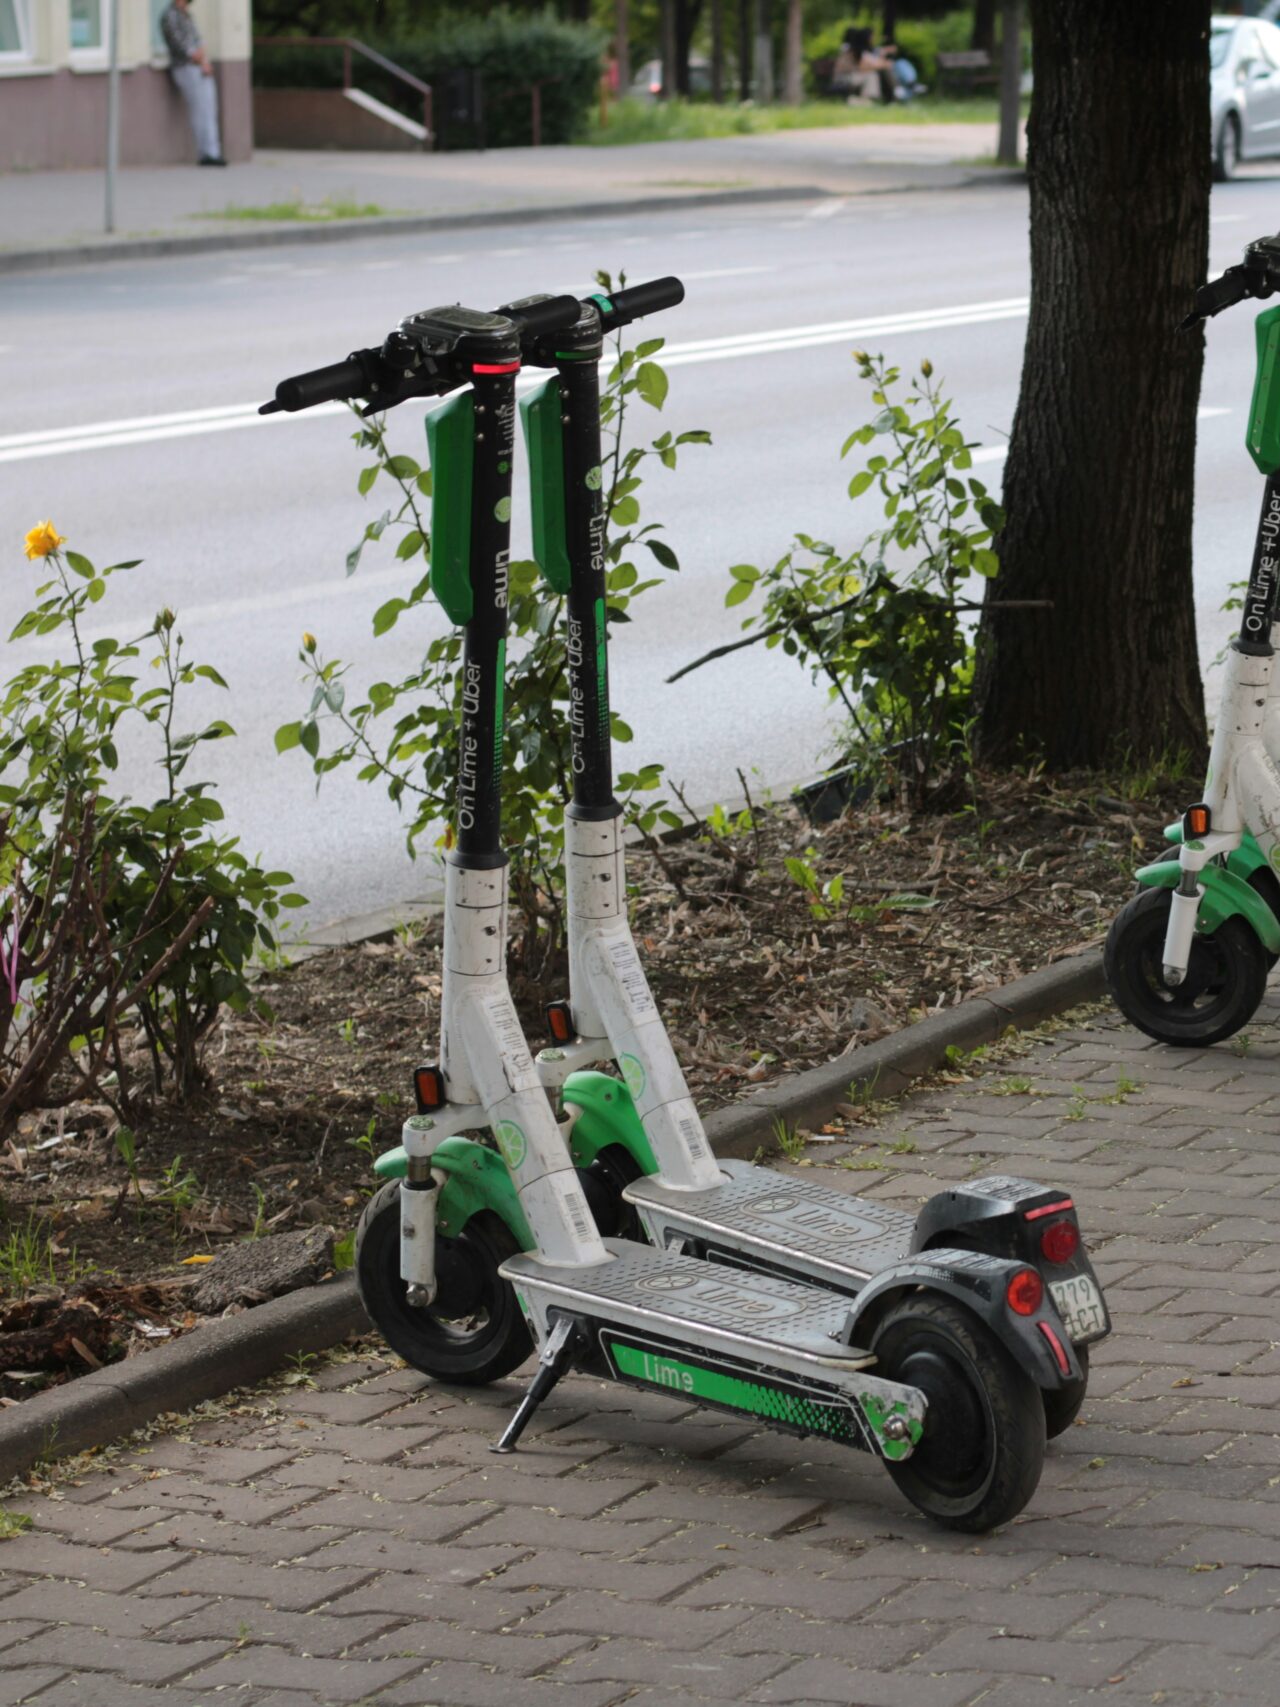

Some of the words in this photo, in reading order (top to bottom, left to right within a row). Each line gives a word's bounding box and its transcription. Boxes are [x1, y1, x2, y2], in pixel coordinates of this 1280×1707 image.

[589, 513, 607, 571] Lime
[494, 549, 510, 609] Lime
[1251, 555, 1274, 600] Lime
[1246, 604, 1266, 631] On
[569, 616, 583, 667] Uber
[464, 660, 482, 715] Uber
[571, 686, 585, 739] Lime
[459, 736, 478, 792] Lime
[572, 746, 585, 774] On
[458, 800, 475, 830] On
[787, 1207, 862, 1237] Lime
[692, 1287, 775, 1314] Lime
[1055, 1278, 1091, 1308] 779
[642, 1352, 694, 1393] Lime
